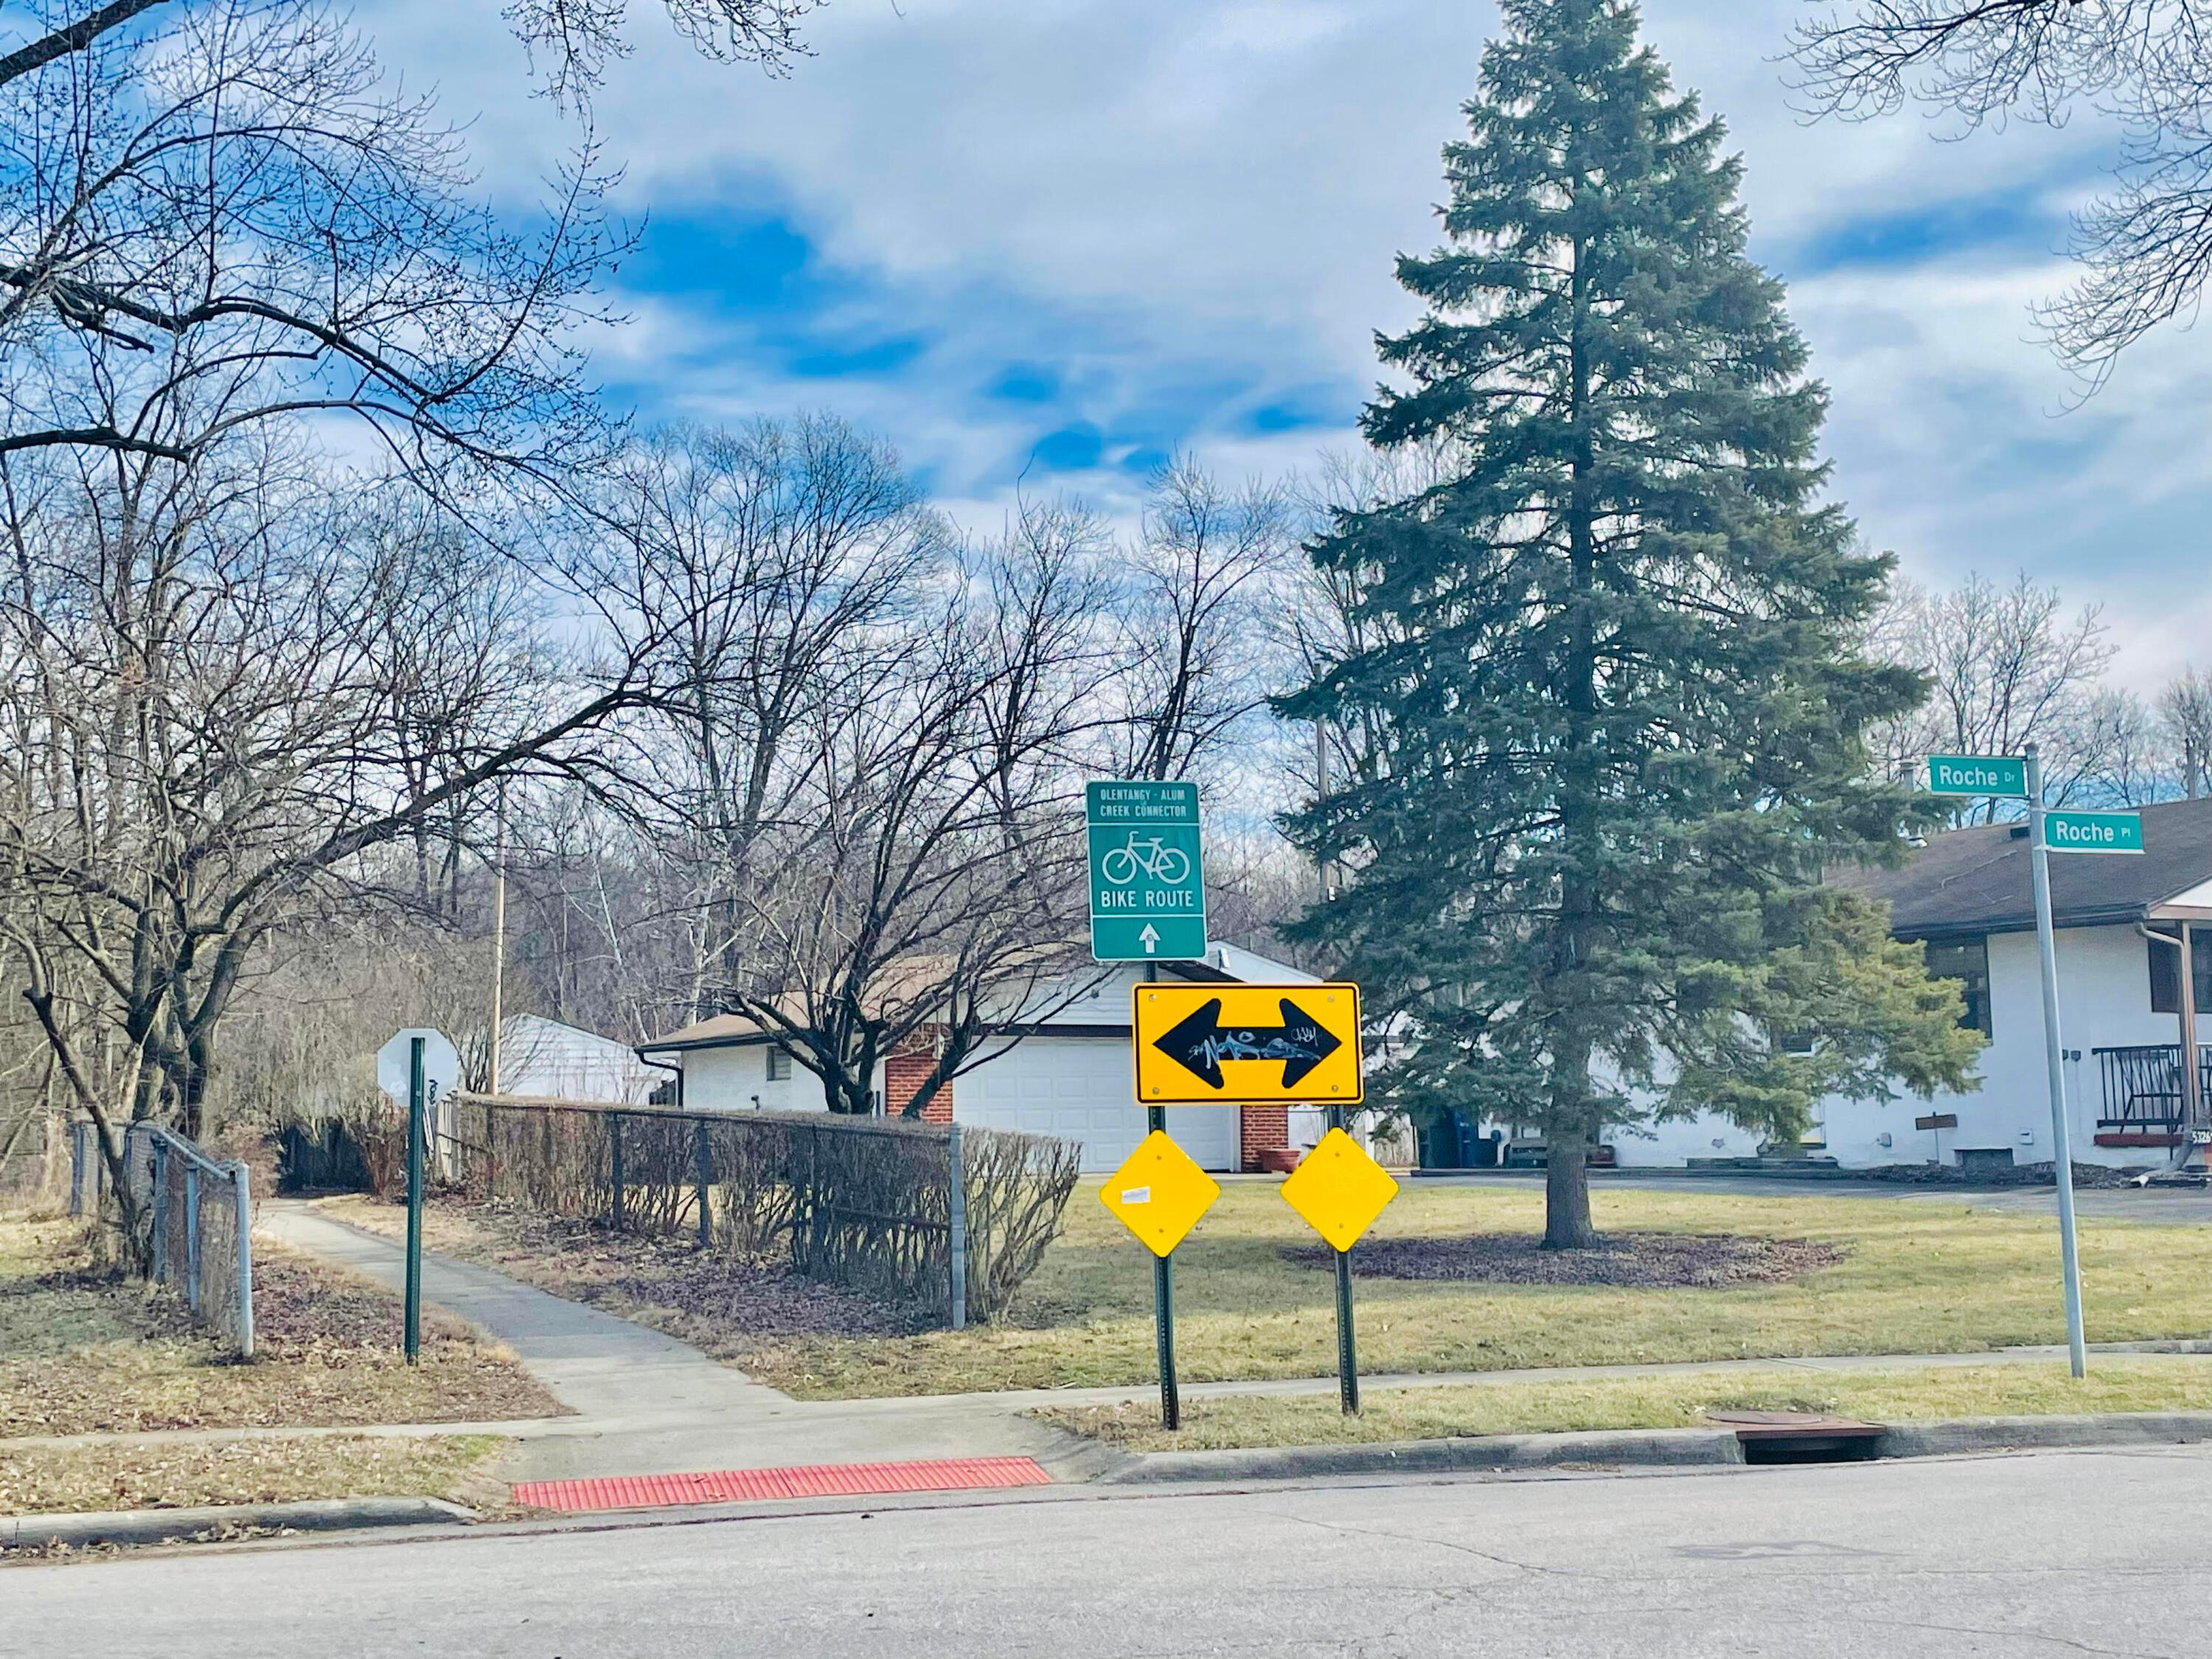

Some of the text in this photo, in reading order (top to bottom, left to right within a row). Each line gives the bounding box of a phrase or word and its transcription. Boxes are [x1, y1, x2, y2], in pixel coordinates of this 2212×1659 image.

[1938, 765, 2016, 787] Roche Dr
[1100, 788, 1150, 801] OLENTANGY
[1161, 789, 1186, 801] ALUM
[1099, 805, 1186, 817] CREEK CONNECTOR
[2056, 820, 2132, 842] Roche Pl
[1101, 890, 1194, 908] BIKE ROUTE
